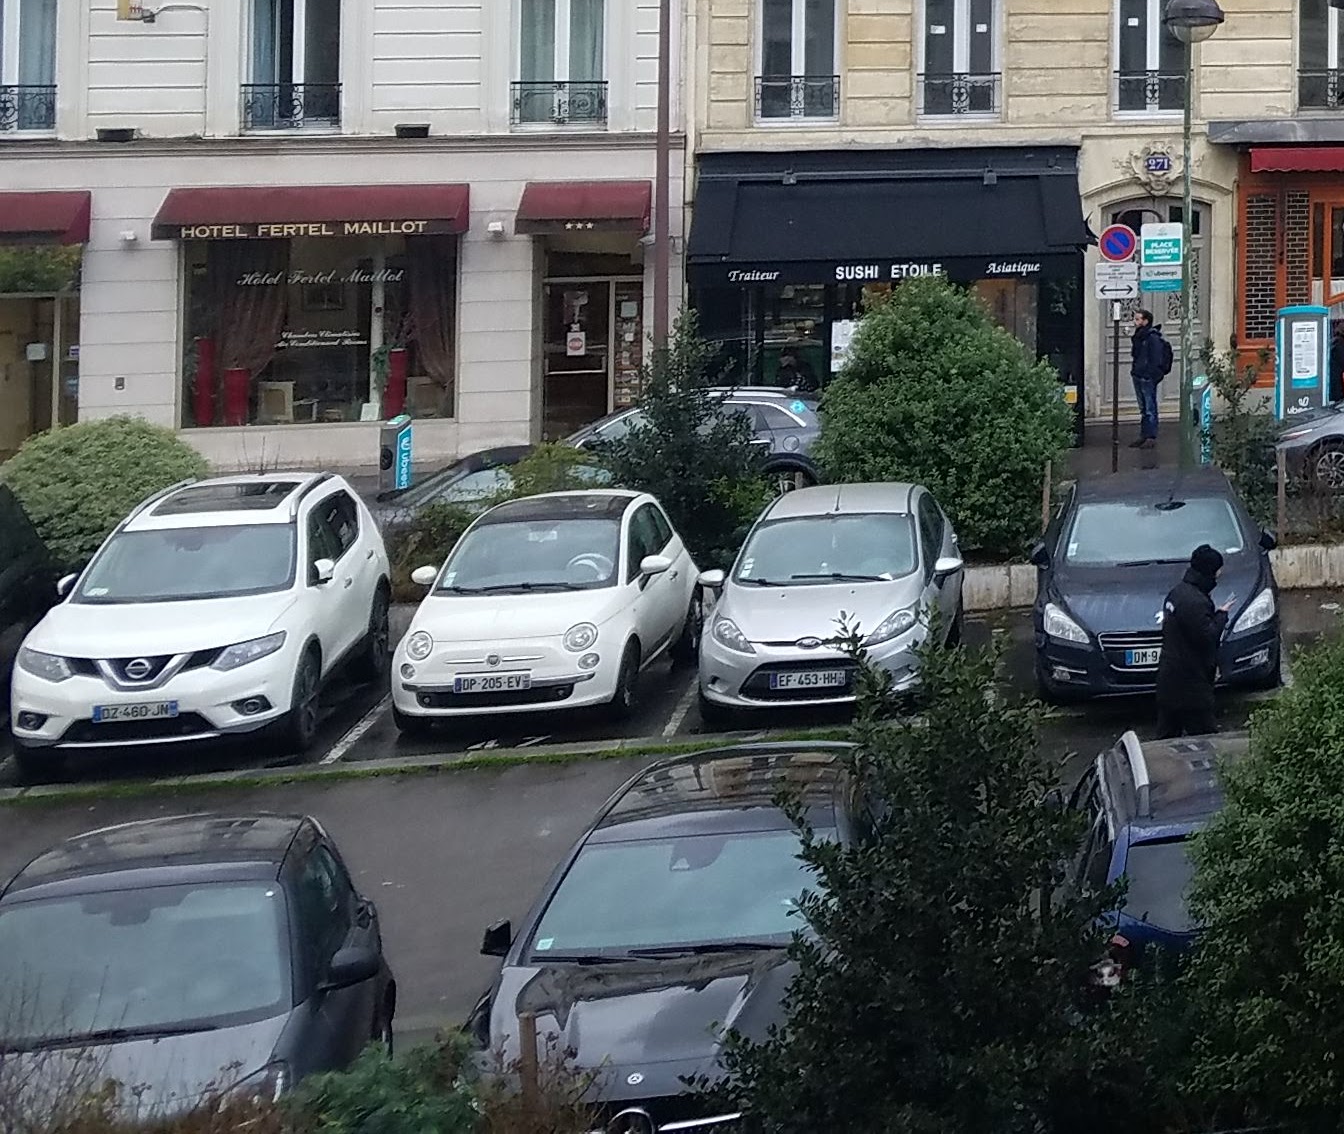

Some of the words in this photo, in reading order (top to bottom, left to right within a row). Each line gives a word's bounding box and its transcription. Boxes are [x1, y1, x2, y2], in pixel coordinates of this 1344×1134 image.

[1148, 158, 1168, 170] 271
[181, 226, 248, 238] HOTEL
[257, 224, 334, 236] FERTEL
[344, 221, 428, 234] MAILLOT
[728, 271, 780, 282] Traiteur
[835, 265, 879, 279] SUSHI
[985, 262, 1041, 276] Asiatique
